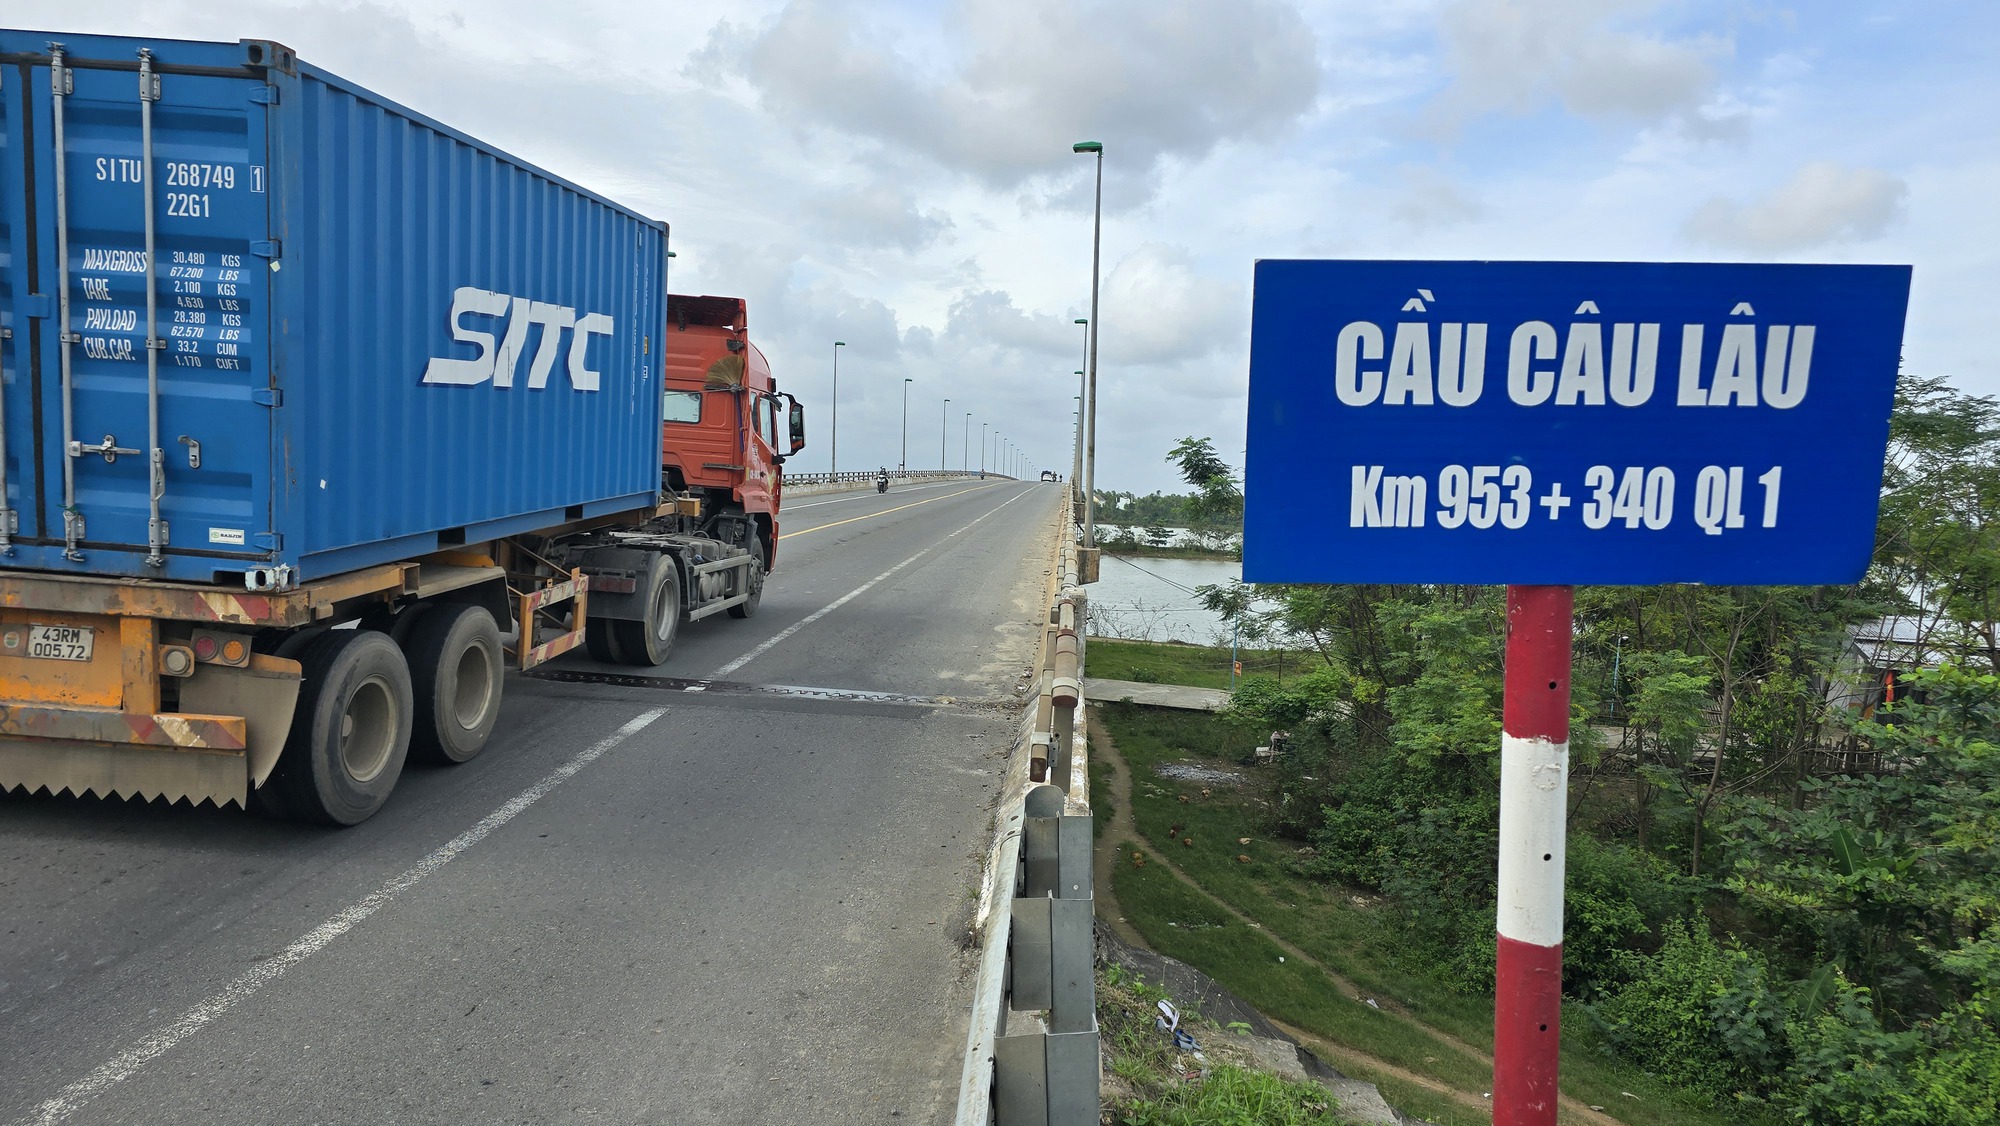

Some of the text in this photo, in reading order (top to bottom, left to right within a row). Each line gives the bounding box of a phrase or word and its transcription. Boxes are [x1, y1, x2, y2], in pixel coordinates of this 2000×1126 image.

[96, 157, 262, 191] SITU 268749 1
[167, 193, 209, 217] 22G1
[82, 248, 240, 272] MAXGROSS 30.480 KGS
[170, 266, 239, 281] 67.200 LBS
[81, 277, 236, 300] TARE 2.100 KGS
[177, 296, 239, 311] 4.630 LBS
[84, 308, 241, 331] PAYLOAD 28.380 KGS
[171, 325, 239, 340] 62.570 LBS
[422, 286, 614, 391] SITC
[84, 337, 237, 360] CUB.CAP. 33.2 CUM
[1335, 289, 1816, 409] CẦU CÂU LÂU
[175, 355, 239, 370] 1.170 CUFT
[1350, 465, 1782, 536] Km 953 + 340 QL 1
[42, 627, 81, 643] 43RM
[34, 643, 85, 659] 005.72
